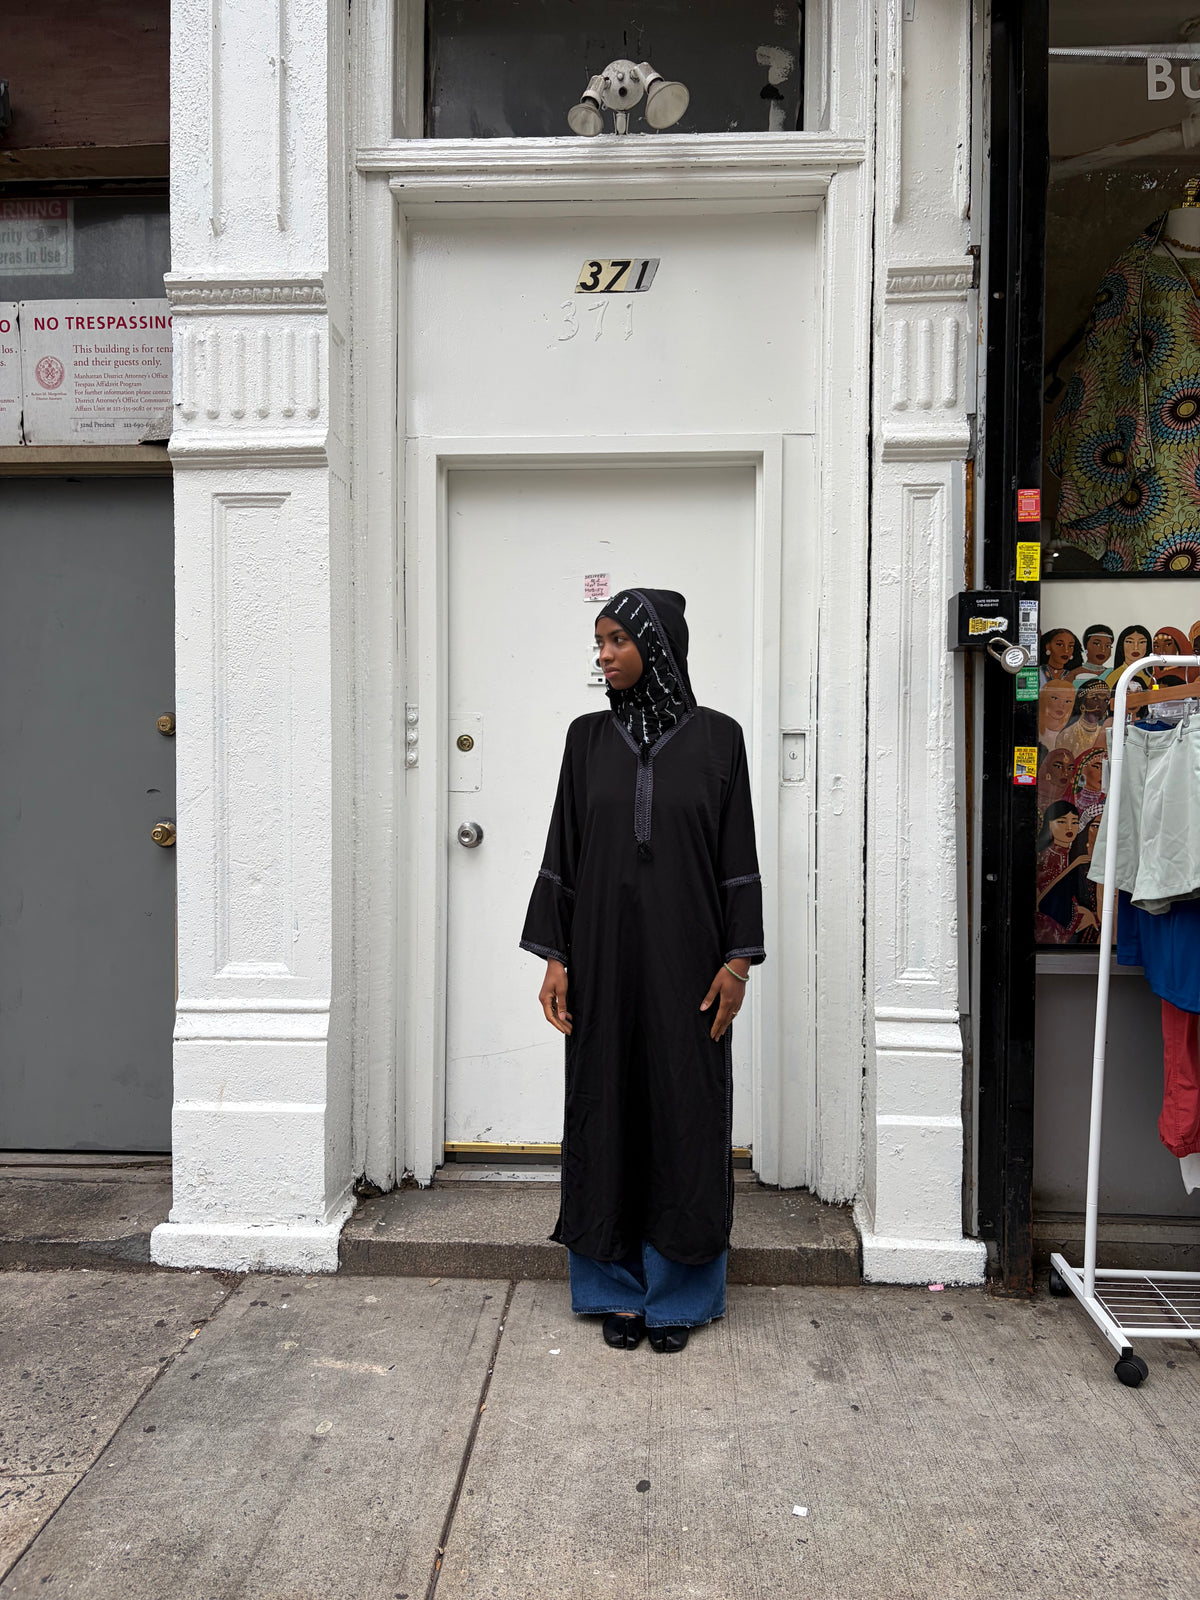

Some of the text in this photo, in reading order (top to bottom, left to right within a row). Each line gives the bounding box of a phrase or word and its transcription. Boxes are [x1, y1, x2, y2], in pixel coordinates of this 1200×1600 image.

[1147, 58, 1200, 100] Bu
[0, 200, 62, 218] RNING
[40, 246, 61, 263] Use
[580, 260, 650, 291] 371
[34, 317, 59, 331] NO
[558, 299, 633, 341] 371
[73, 344, 92, 353] This
[94, 344, 131, 356] building
[132, 344, 139, 353] is
[141, 343, 155, 353] for
[73, 357, 90, 367] and
[91, 357, 111, 367] their
[113, 359, 140, 368] guests
